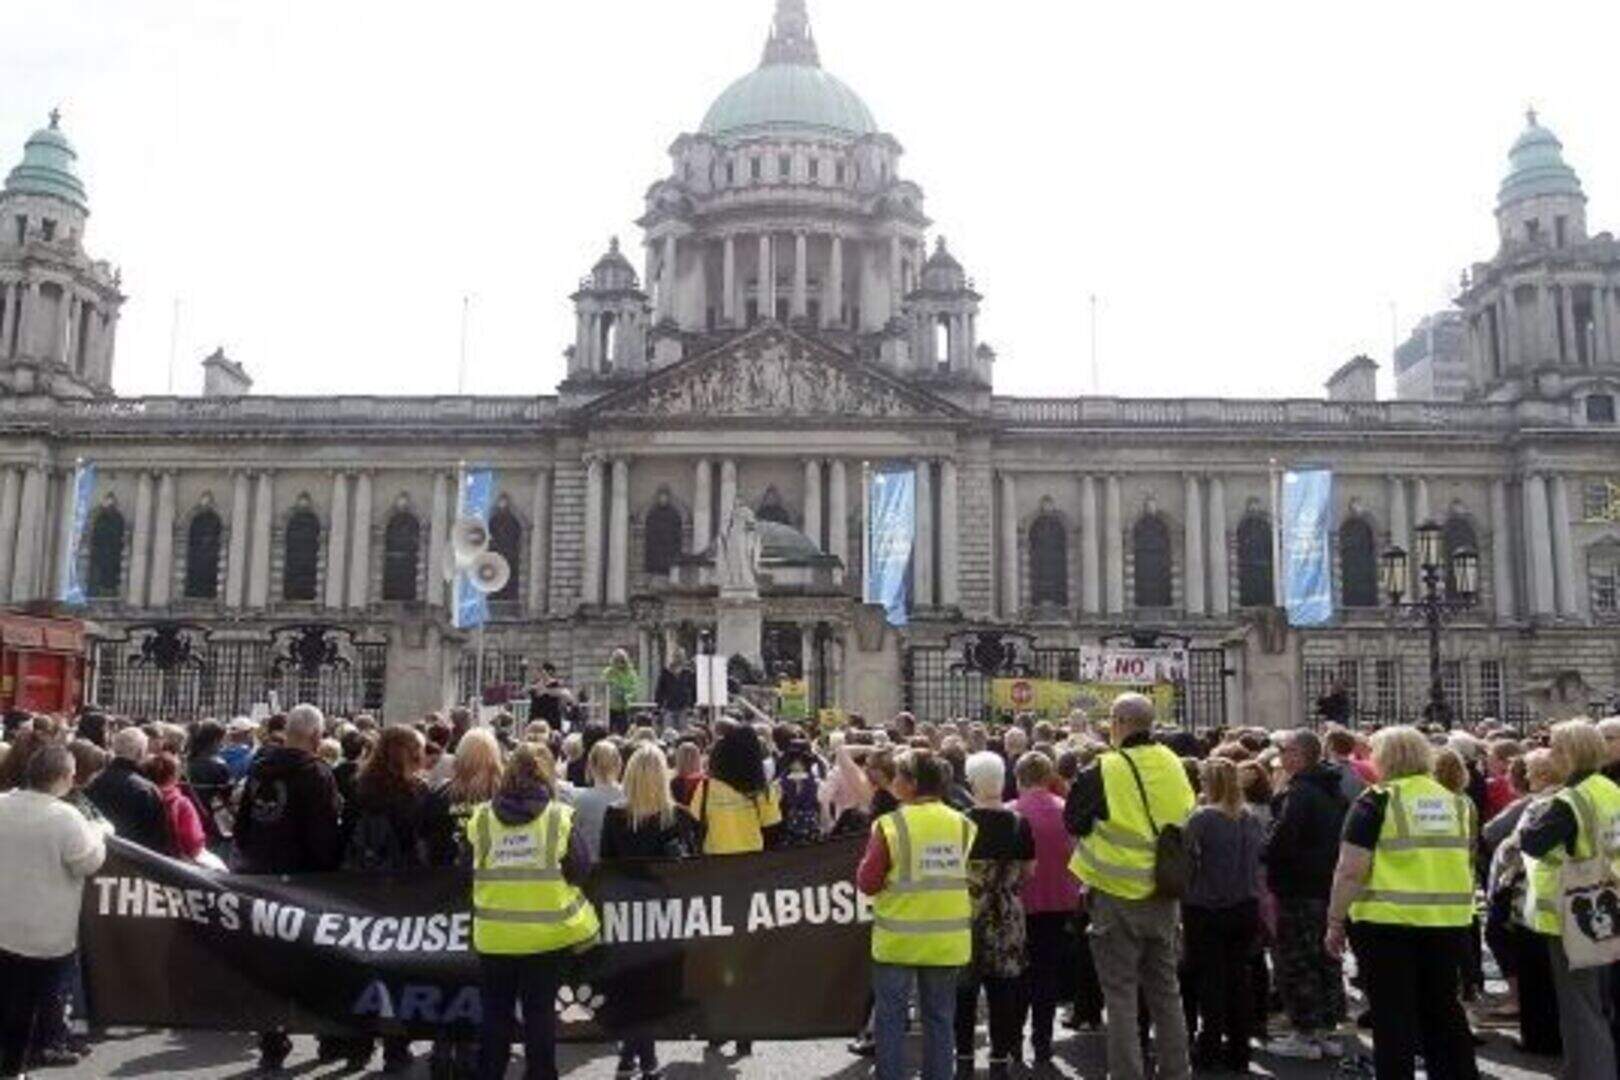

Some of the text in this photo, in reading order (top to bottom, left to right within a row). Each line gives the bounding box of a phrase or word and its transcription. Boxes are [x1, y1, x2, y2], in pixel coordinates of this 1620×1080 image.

[1115, 657, 1145, 676] NO
[95, 877, 874, 951] THERE'S NO EXCUSE NIMAL ABUSE
